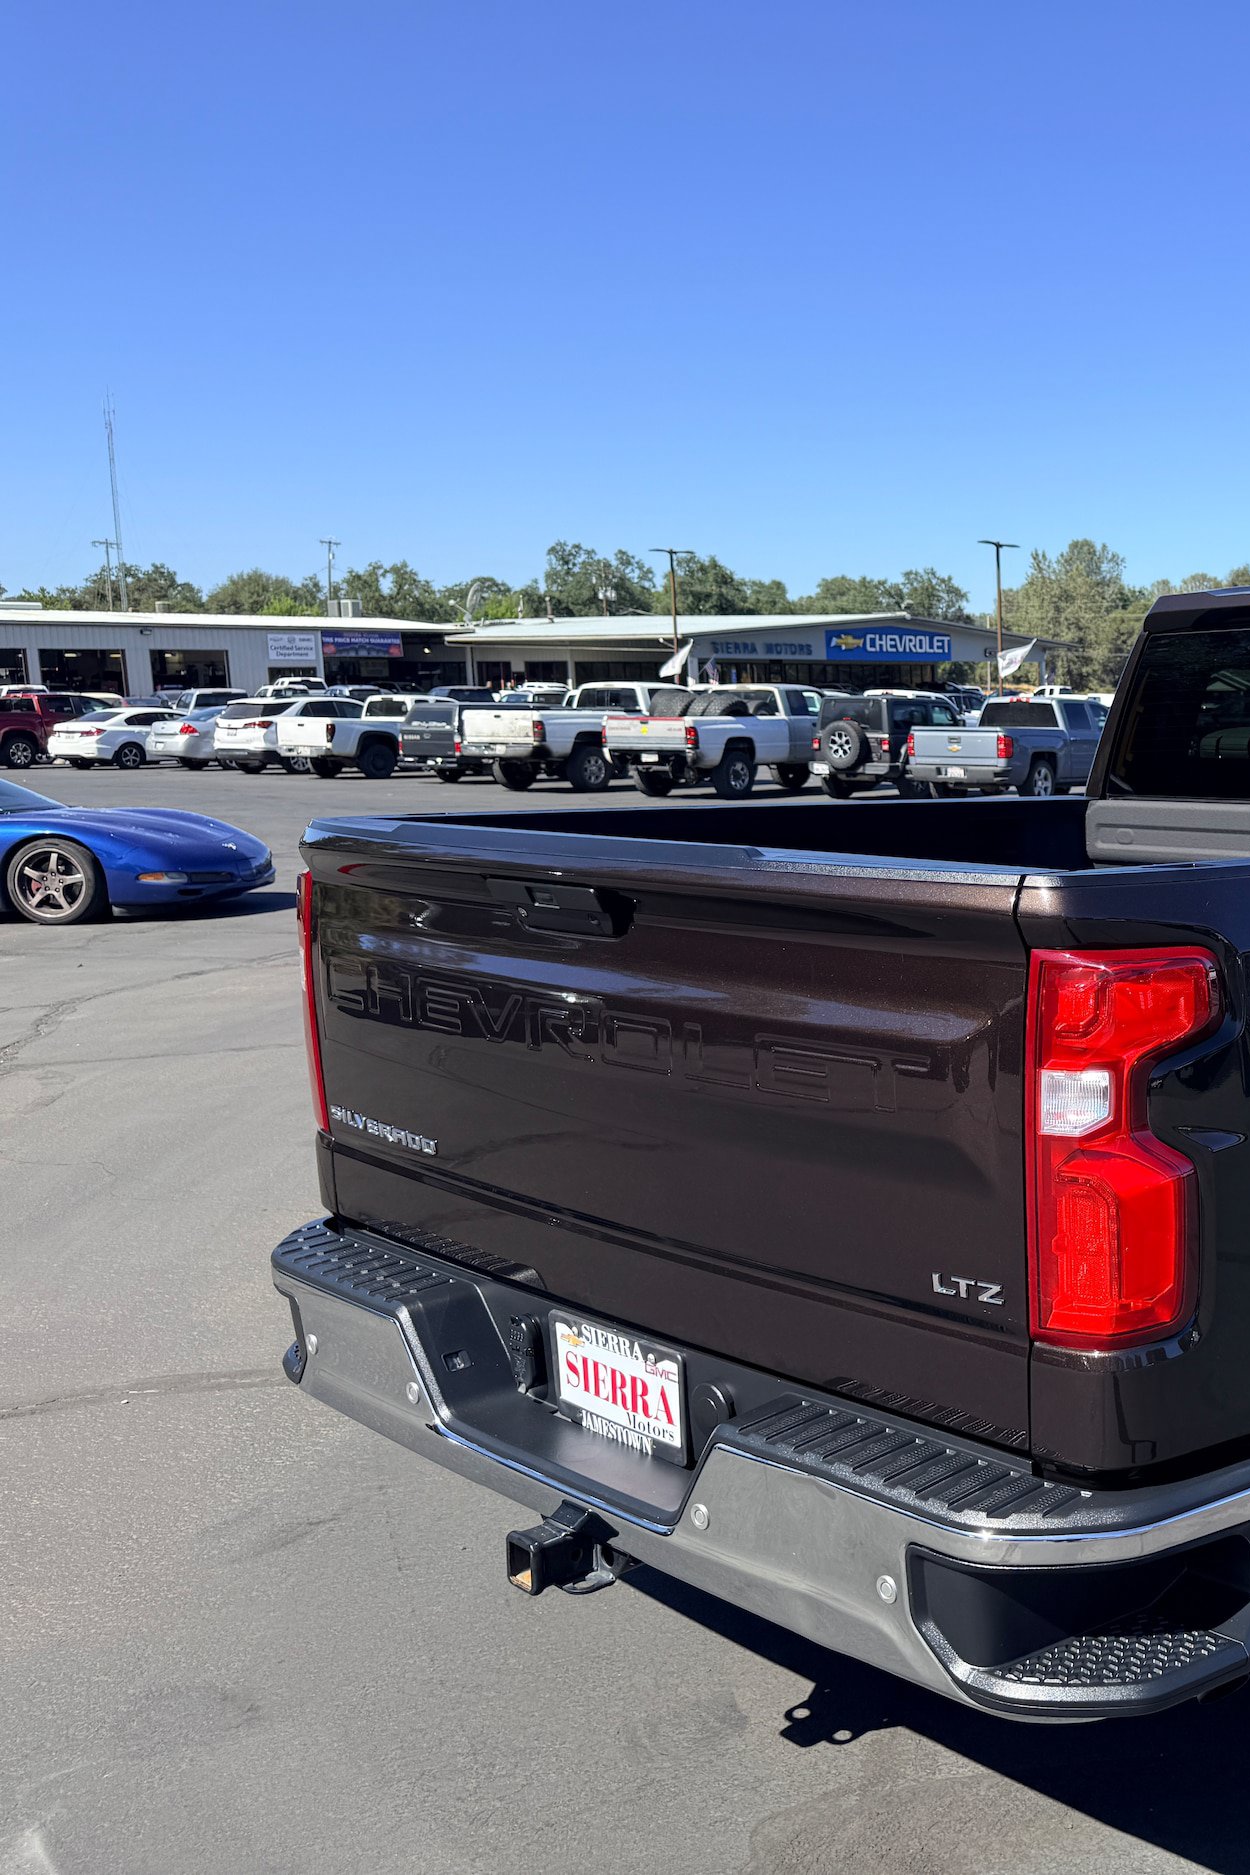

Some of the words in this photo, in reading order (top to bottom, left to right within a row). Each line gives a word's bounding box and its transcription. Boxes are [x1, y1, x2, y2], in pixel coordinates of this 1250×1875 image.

[710, 641, 758, 654] SIERRA
[764, 643, 812, 656] MOTORS
[866, 634, 950, 653] CHEVROLET
[328, 956, 932, 1112] CHEVROLET
[330, 1104, 438, 1156] SILVERADO
[932, 1272, 1004, 1304] LTZ
[581, 1324, 646, 1362] SIERRA
[566, 1351, 677, 1427] SIERRA
[644, 1361, 678, 1383] GMC
[581, 1410, 652, 1455] JAMESTOWN
[626, 1412, 675, 1442] Motors
